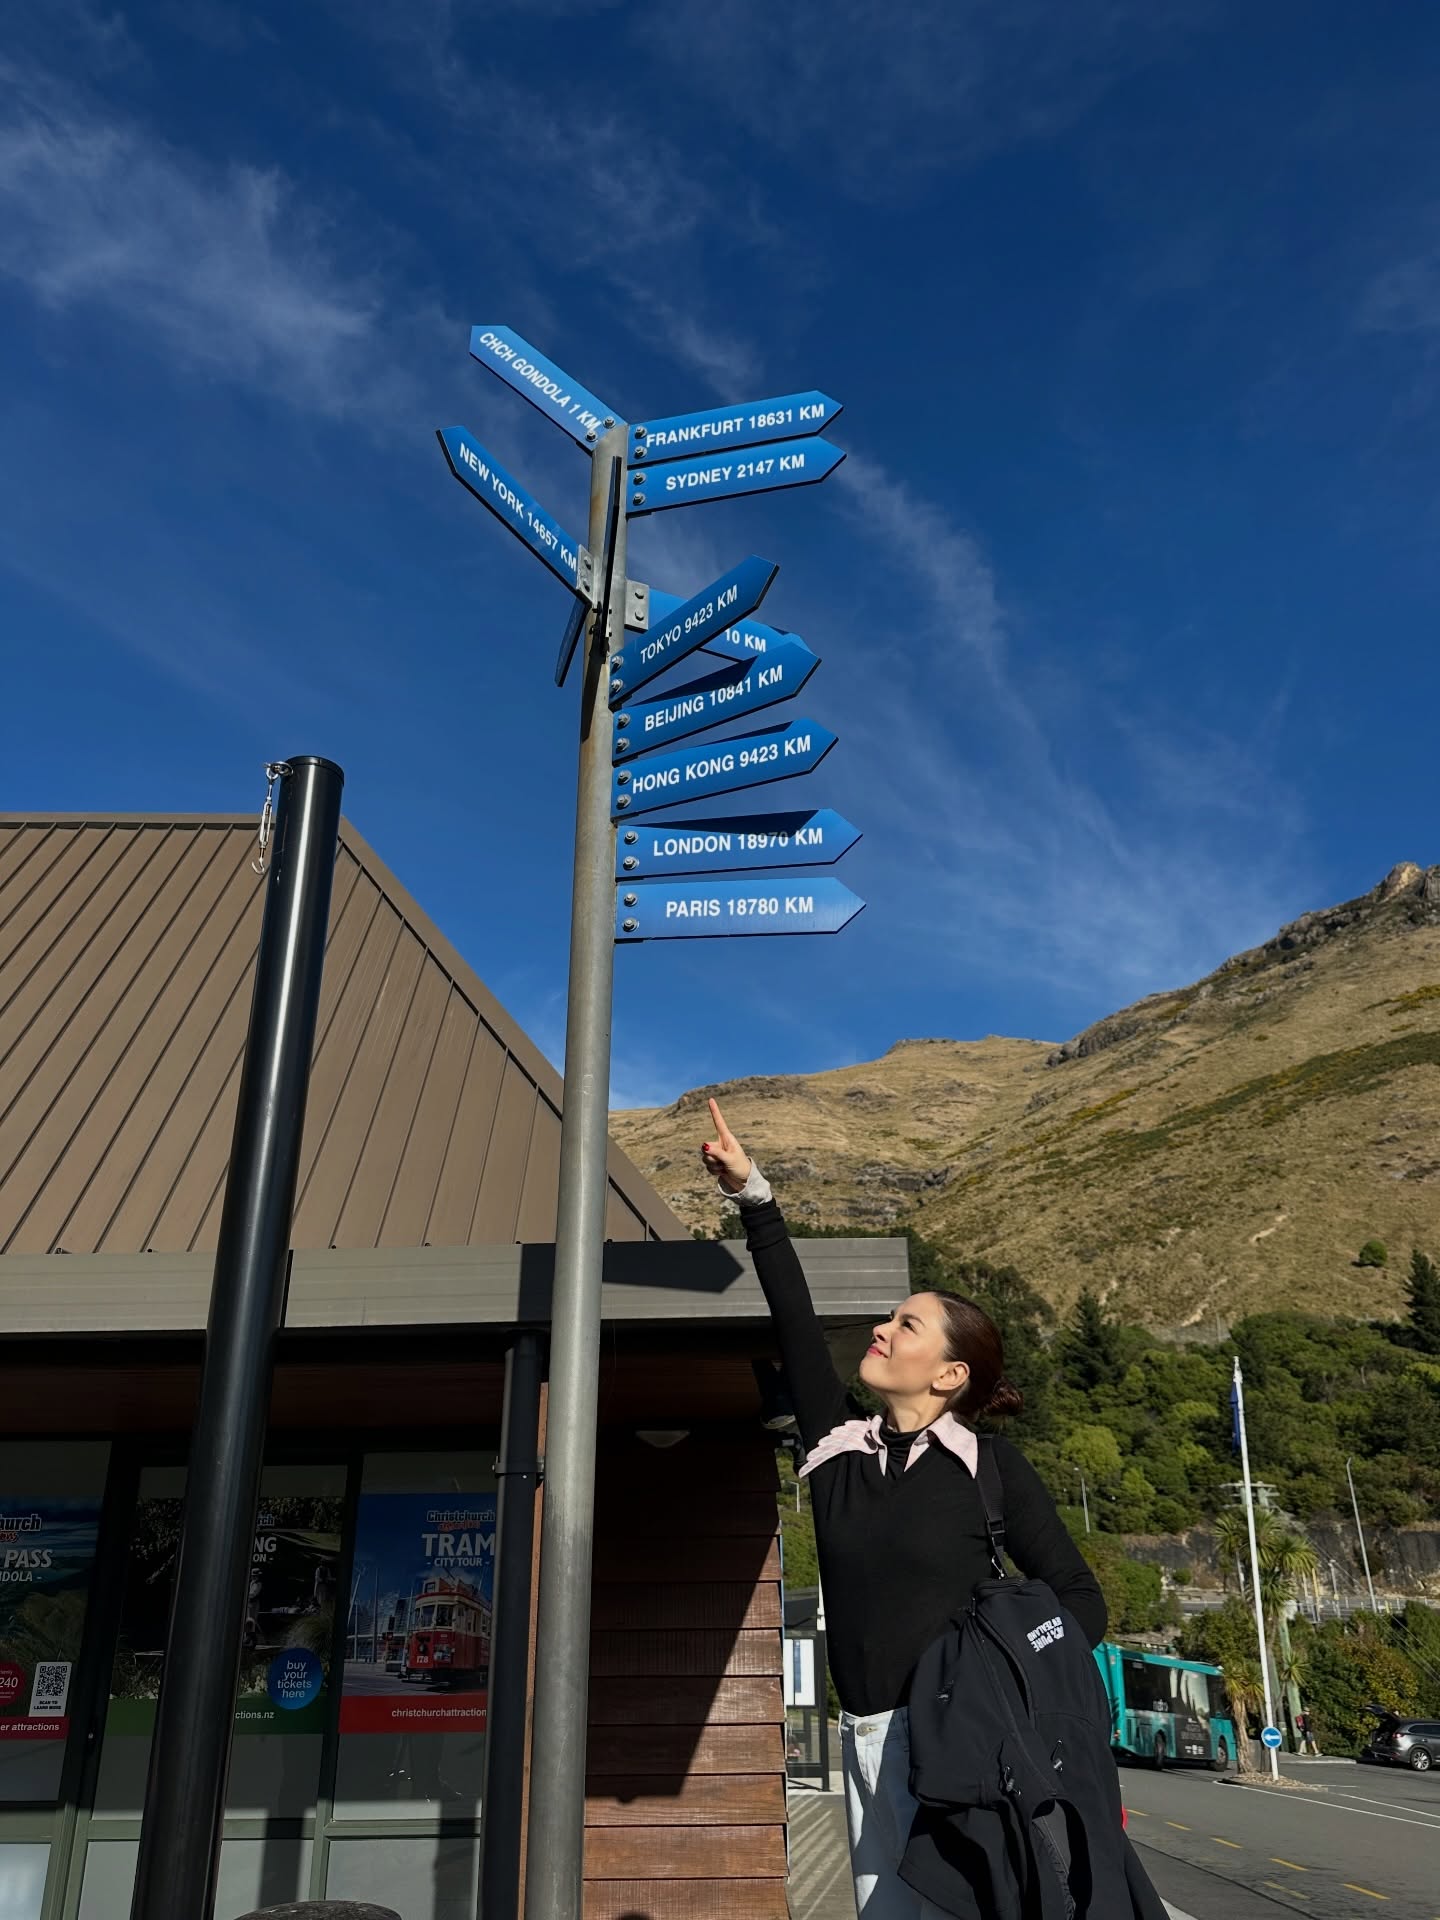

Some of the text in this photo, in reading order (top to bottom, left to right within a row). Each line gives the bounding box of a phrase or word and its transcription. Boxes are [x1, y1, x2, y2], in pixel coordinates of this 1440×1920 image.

[480, 332, 601, 431] CHCH GONDOLA 1 KM
[645, 403, 825, 448] FRANKFURT 18631 KM
[665, 453, 805, 491] SYDNEY 2147 KM
[460, 442, 577, 572] NEW YORK 14657 KM
[640, 584, 738, 665] TOKYO 9423 KM
[744, 633, 766, 653] KM
[644, 664, 783, 732] BEIJING 10841 KM
[632, 735, 811, 794] HONG KONG 9423 KM
[653, 827, 823, 857] LONDON 18970 KM
[665, 896, 814, 918] PARIS 18780 KM
[421, 1533, 496, 1556] TRAM
[4, 1549, 53, 1568] PASS
[434, 1557, 483, 1567] CITY TOUR
[0, 1570, 33, 1582] DOLA
[284, 1671, 308, 1681] your
[286, 1660, 307, 1672] buy
[277, 1680, 312, 1689] tickets
[282, 1689, 306, 1699] here
[11, 1722, 60, 1731] attractions
